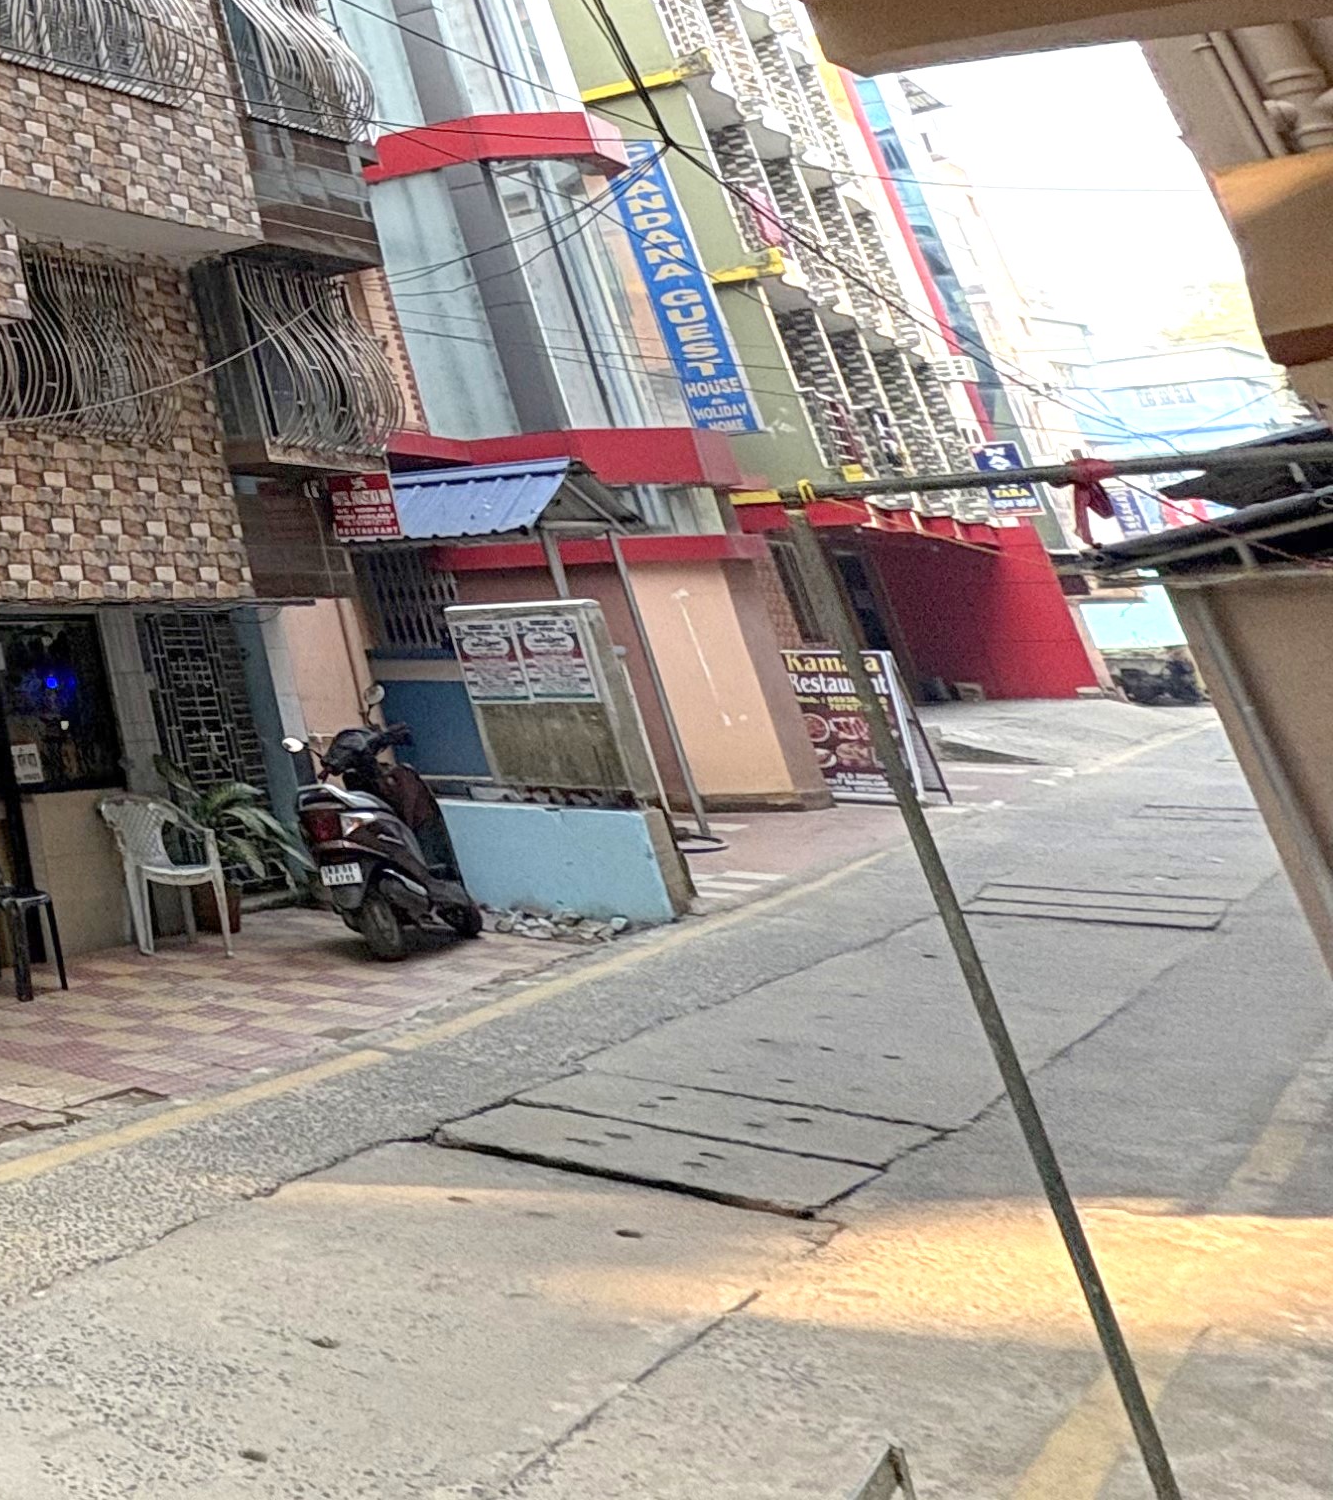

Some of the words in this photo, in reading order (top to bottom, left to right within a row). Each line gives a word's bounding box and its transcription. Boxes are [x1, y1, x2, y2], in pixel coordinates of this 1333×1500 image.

[660, 288, 724, 377] GUEST
[685, 377, 742, 398] HOUSE
[692, 403, 748, 420] HOLIDAY
[708, 418, 748, 431] HOME
[785, 653, 881, 672] Kama
[788, 673, 889, 694] Restaunt
